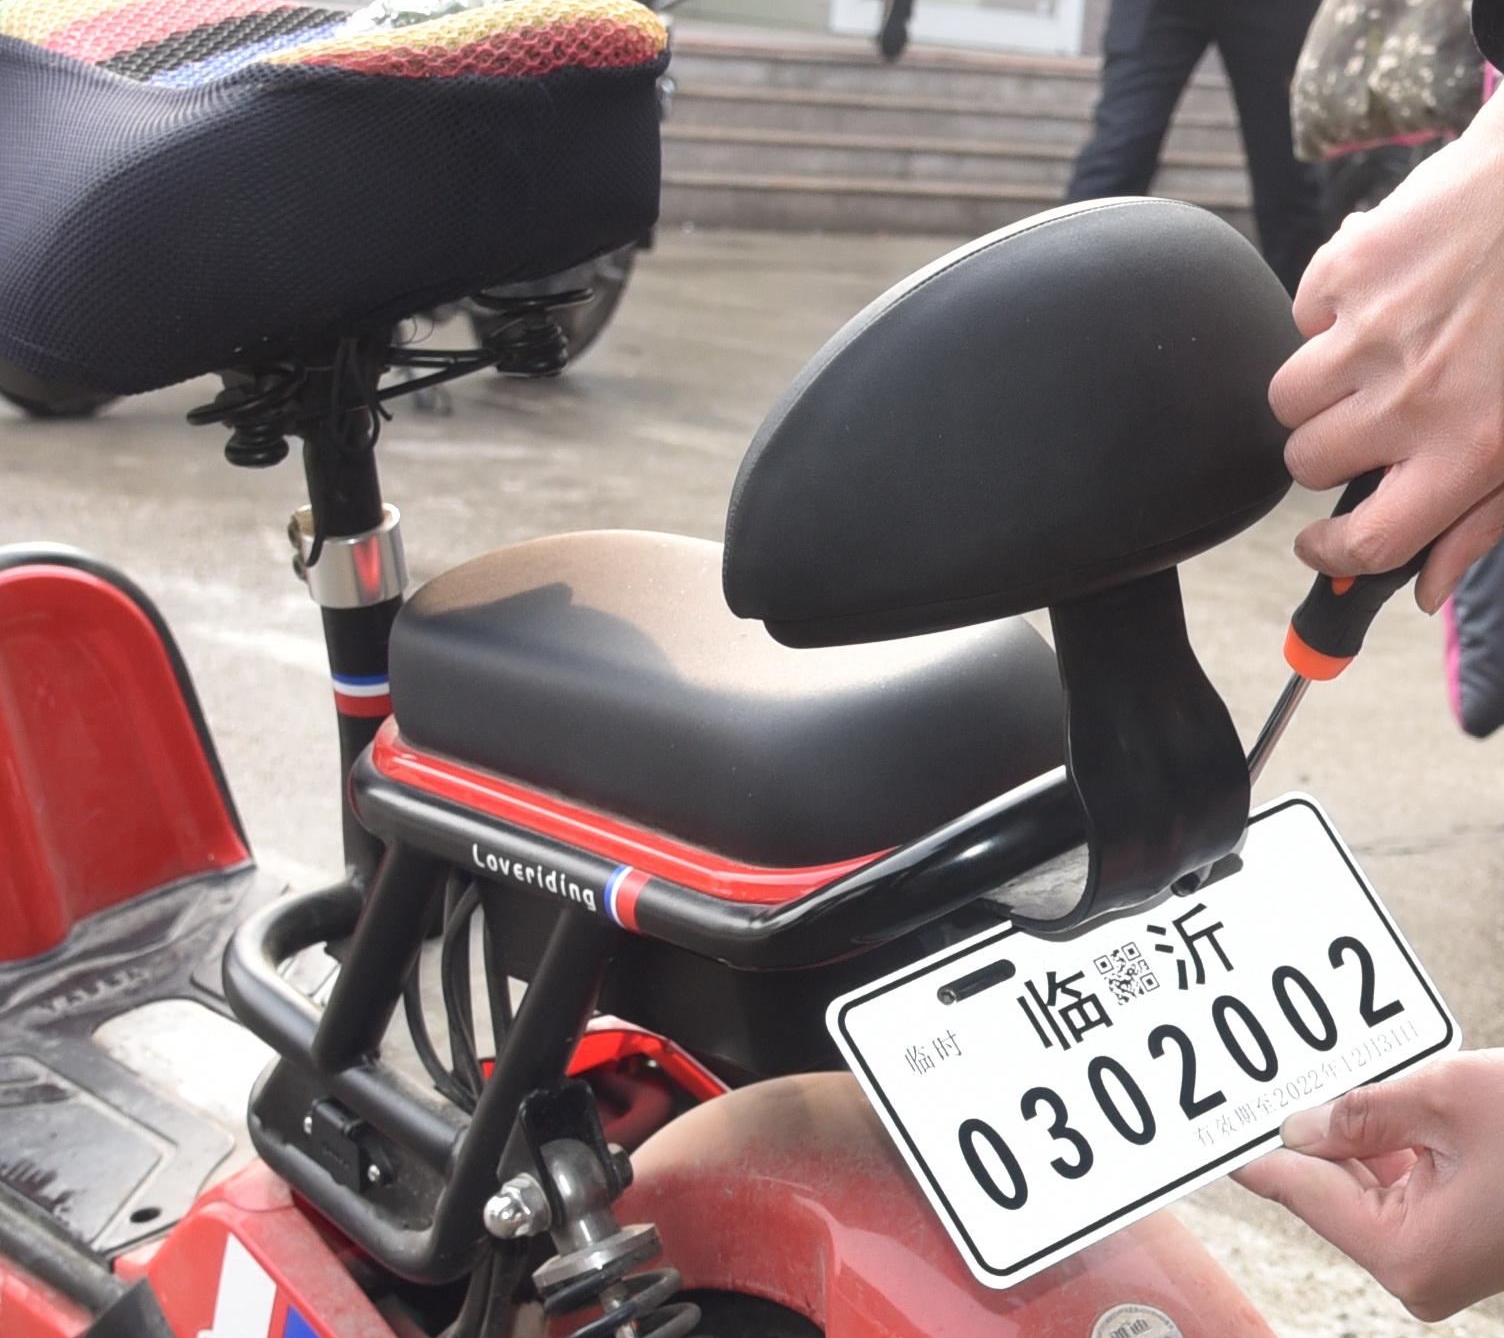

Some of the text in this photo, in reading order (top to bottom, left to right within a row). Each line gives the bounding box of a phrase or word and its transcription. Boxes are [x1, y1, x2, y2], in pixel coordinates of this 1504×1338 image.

[472, 842, 597, 912] Loveriding
[1016, 901, 1237, 1053] 临沂
[904, 1029, 962, 1075] 临时
[956, 935, 1407, 1212] 0302002
